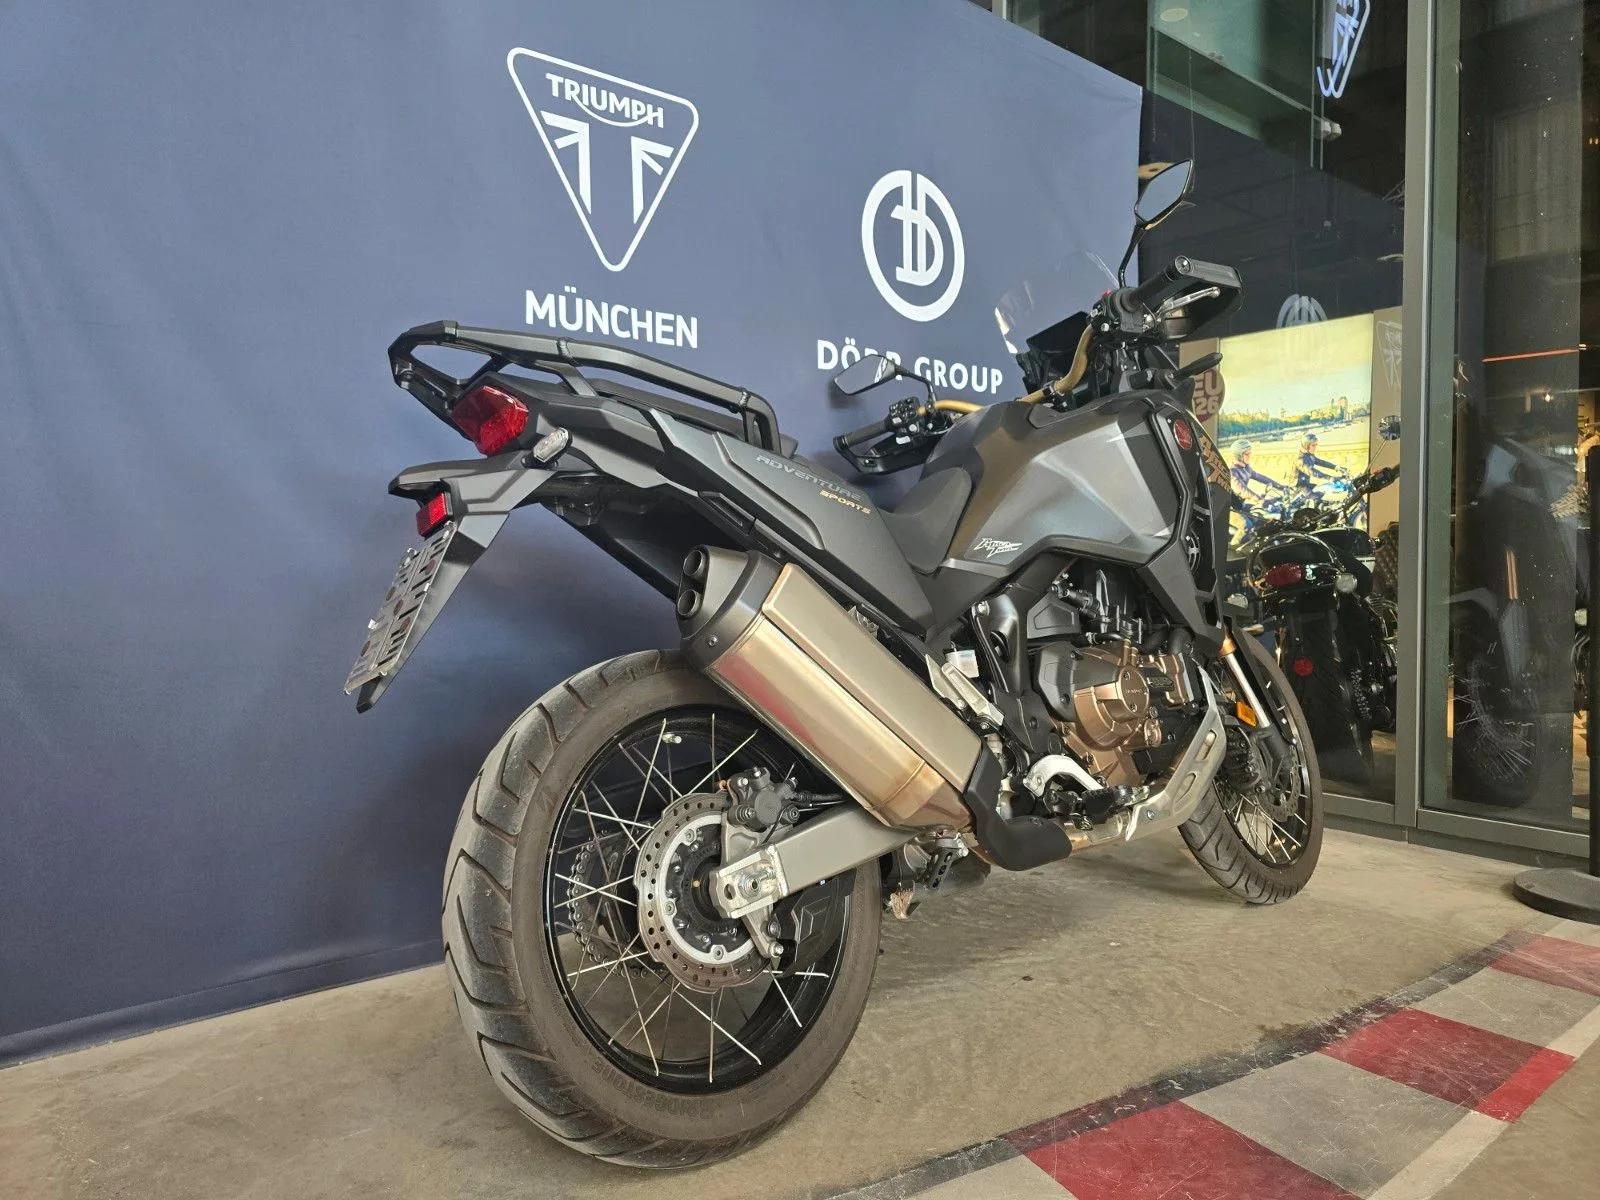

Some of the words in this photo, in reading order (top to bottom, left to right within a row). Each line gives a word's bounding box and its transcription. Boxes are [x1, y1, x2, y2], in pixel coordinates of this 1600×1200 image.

[545, 72, 664, 128] TRIUMPH
[525, 285, 698, 349] MÜNCHEN
[817, 336, 902, 381] DÖ
[914, 356, 1003, 394] GROUP
[756, 454, 862, 502] ADVENTURE
[819, 489, 872, 515] SPORTS
